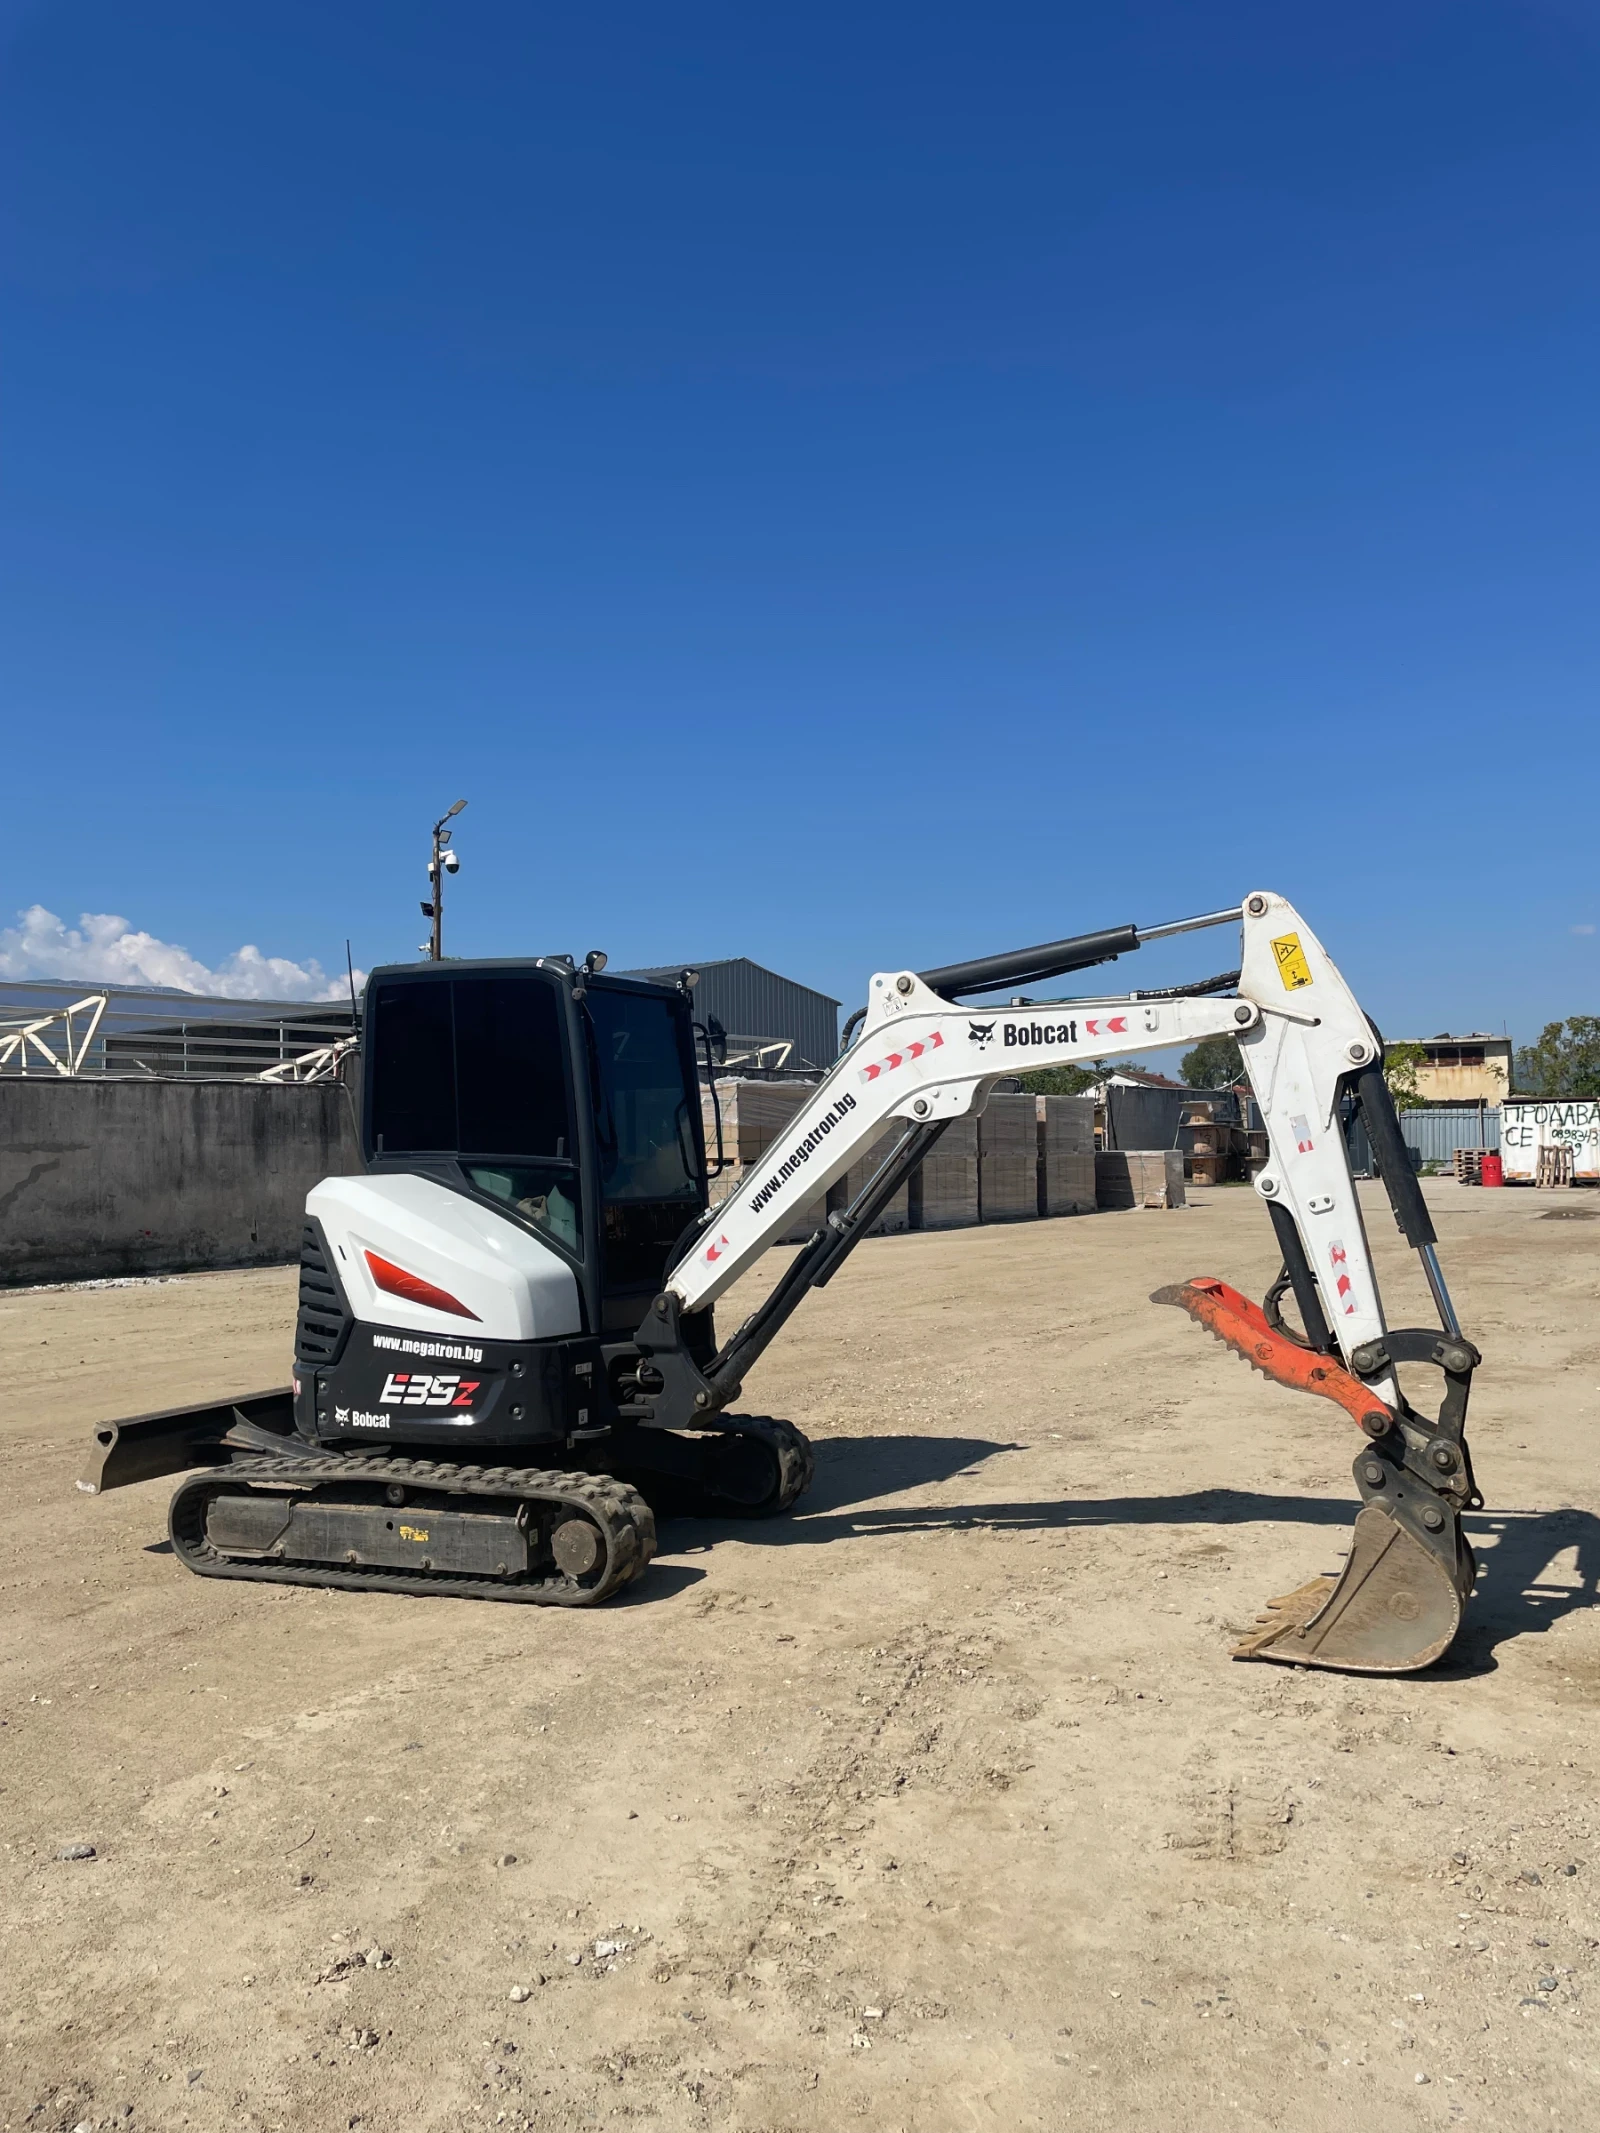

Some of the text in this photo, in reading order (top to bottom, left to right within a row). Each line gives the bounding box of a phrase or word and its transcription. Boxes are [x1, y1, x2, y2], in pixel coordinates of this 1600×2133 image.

[1004, 1020, 1078, 1046] Bobcat
[1505, 1126, 1534, 1148] СЕ
[748, 1092, 857, 1214] www.megatron.bg
[372, 1334, 483, 1363] www.megatron.bg
[352, 1411, 391, 1428] Bobcat
